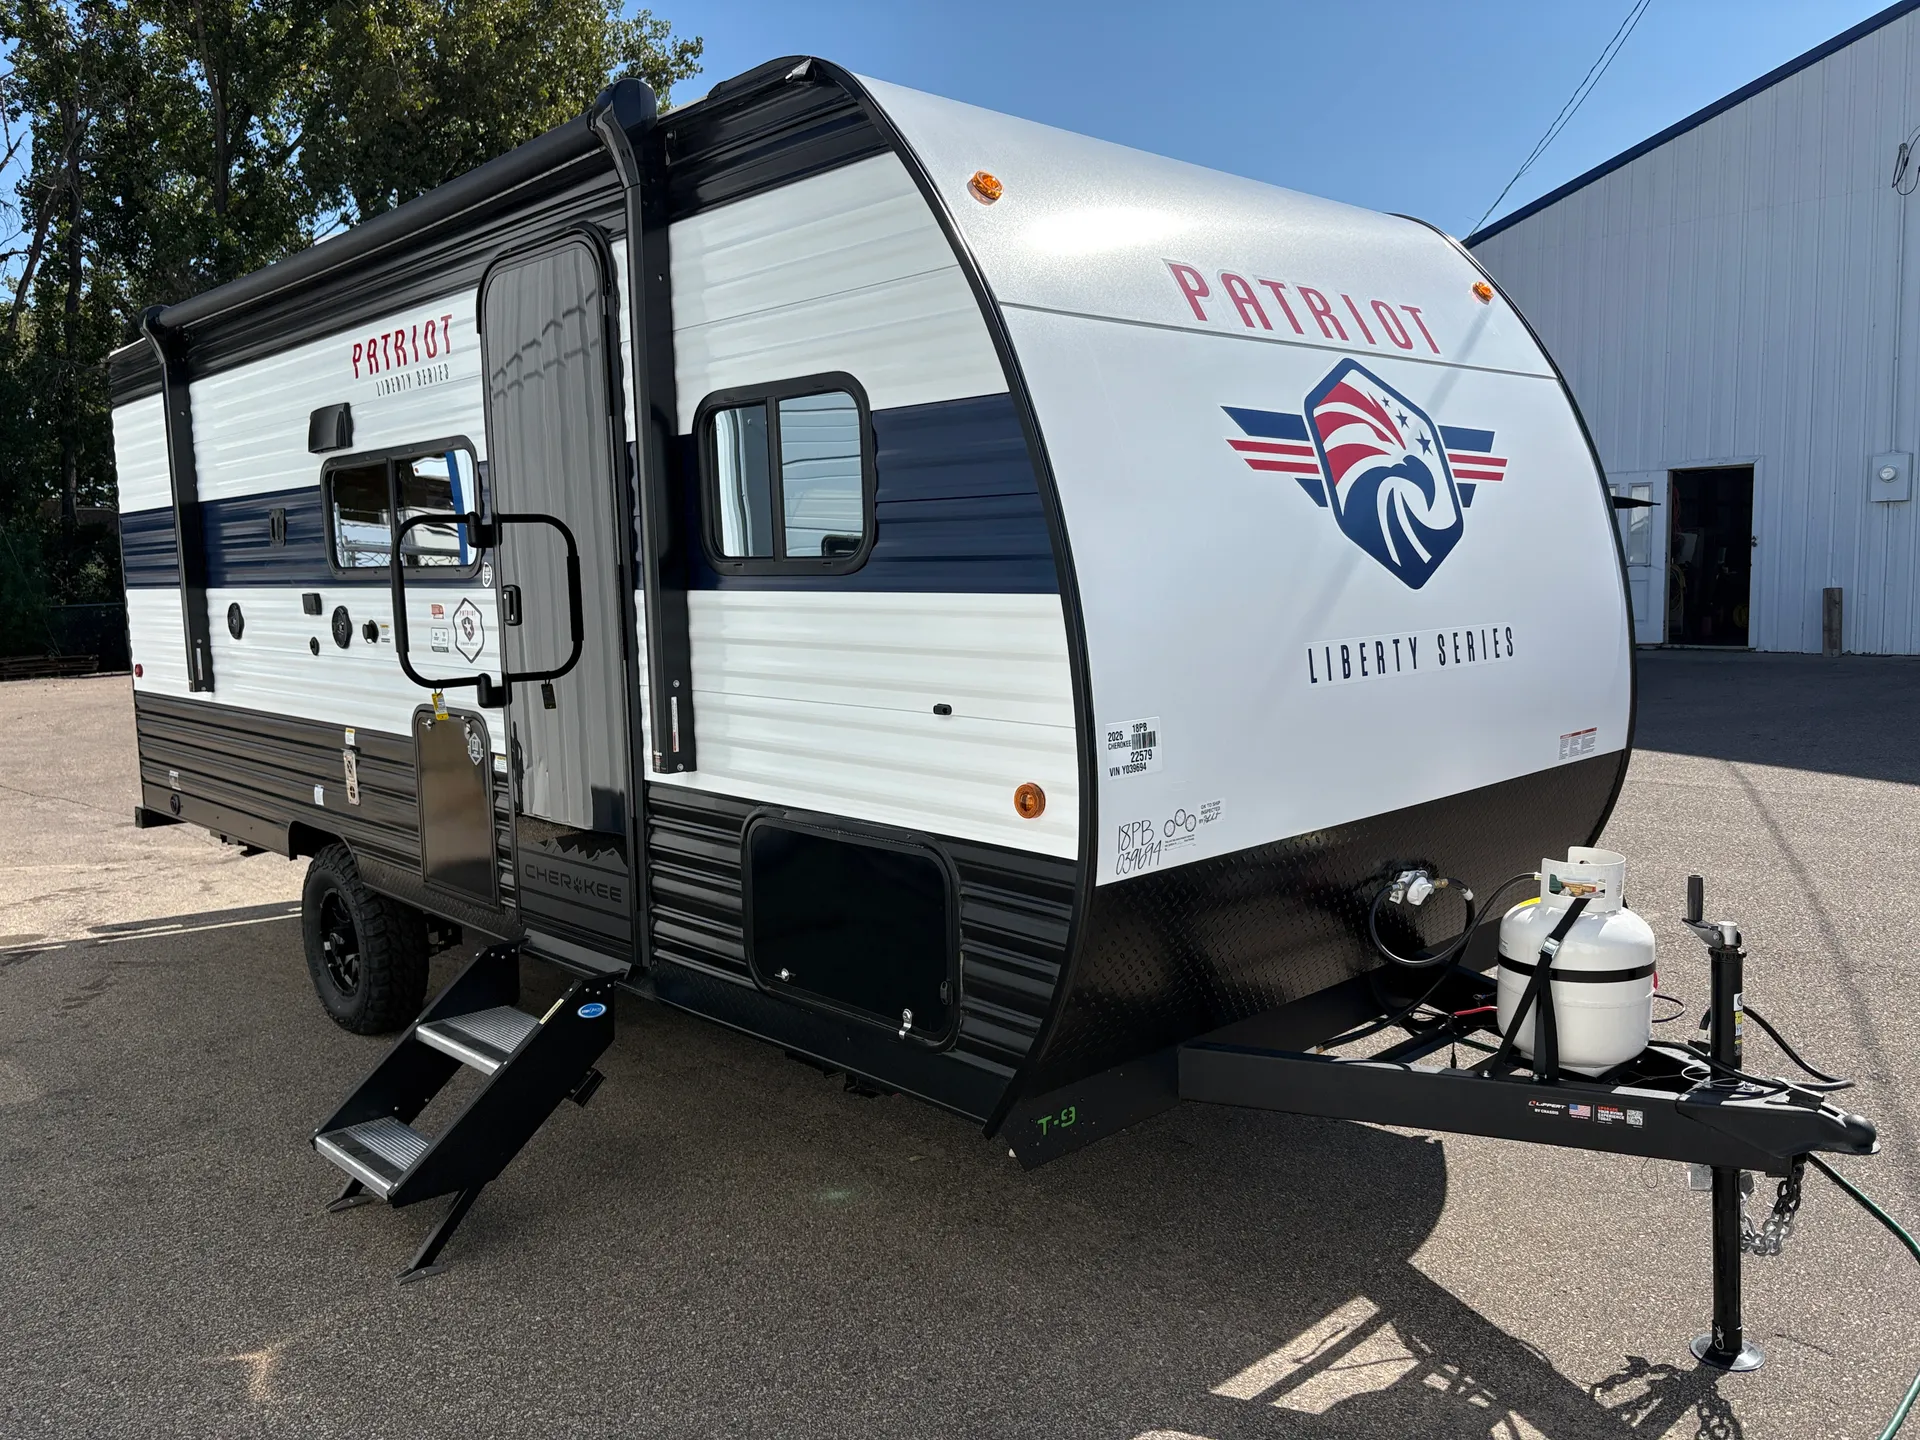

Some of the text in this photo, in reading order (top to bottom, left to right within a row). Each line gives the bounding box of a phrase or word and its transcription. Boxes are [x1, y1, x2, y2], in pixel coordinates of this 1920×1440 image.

[1167, 262, 1441, 355] PATRIOT
[352, 314, 452, 379] PATRIOT
[376, 363, 449, 396] LIBERTY SERIES
[1308, 626, 1514, 684] LIBERTY SERIES
[1107, 730, 1124, 742] 2026
[1132, 722, 1147, 733] 18PB
[1107, 740, 1131, 750] CHEROKEE
[1131, 748, 1153, 763] 22579
[1109, 762, 1147, 777] VIN Y039694
[1117, 819, 1155, 854] 18PB
